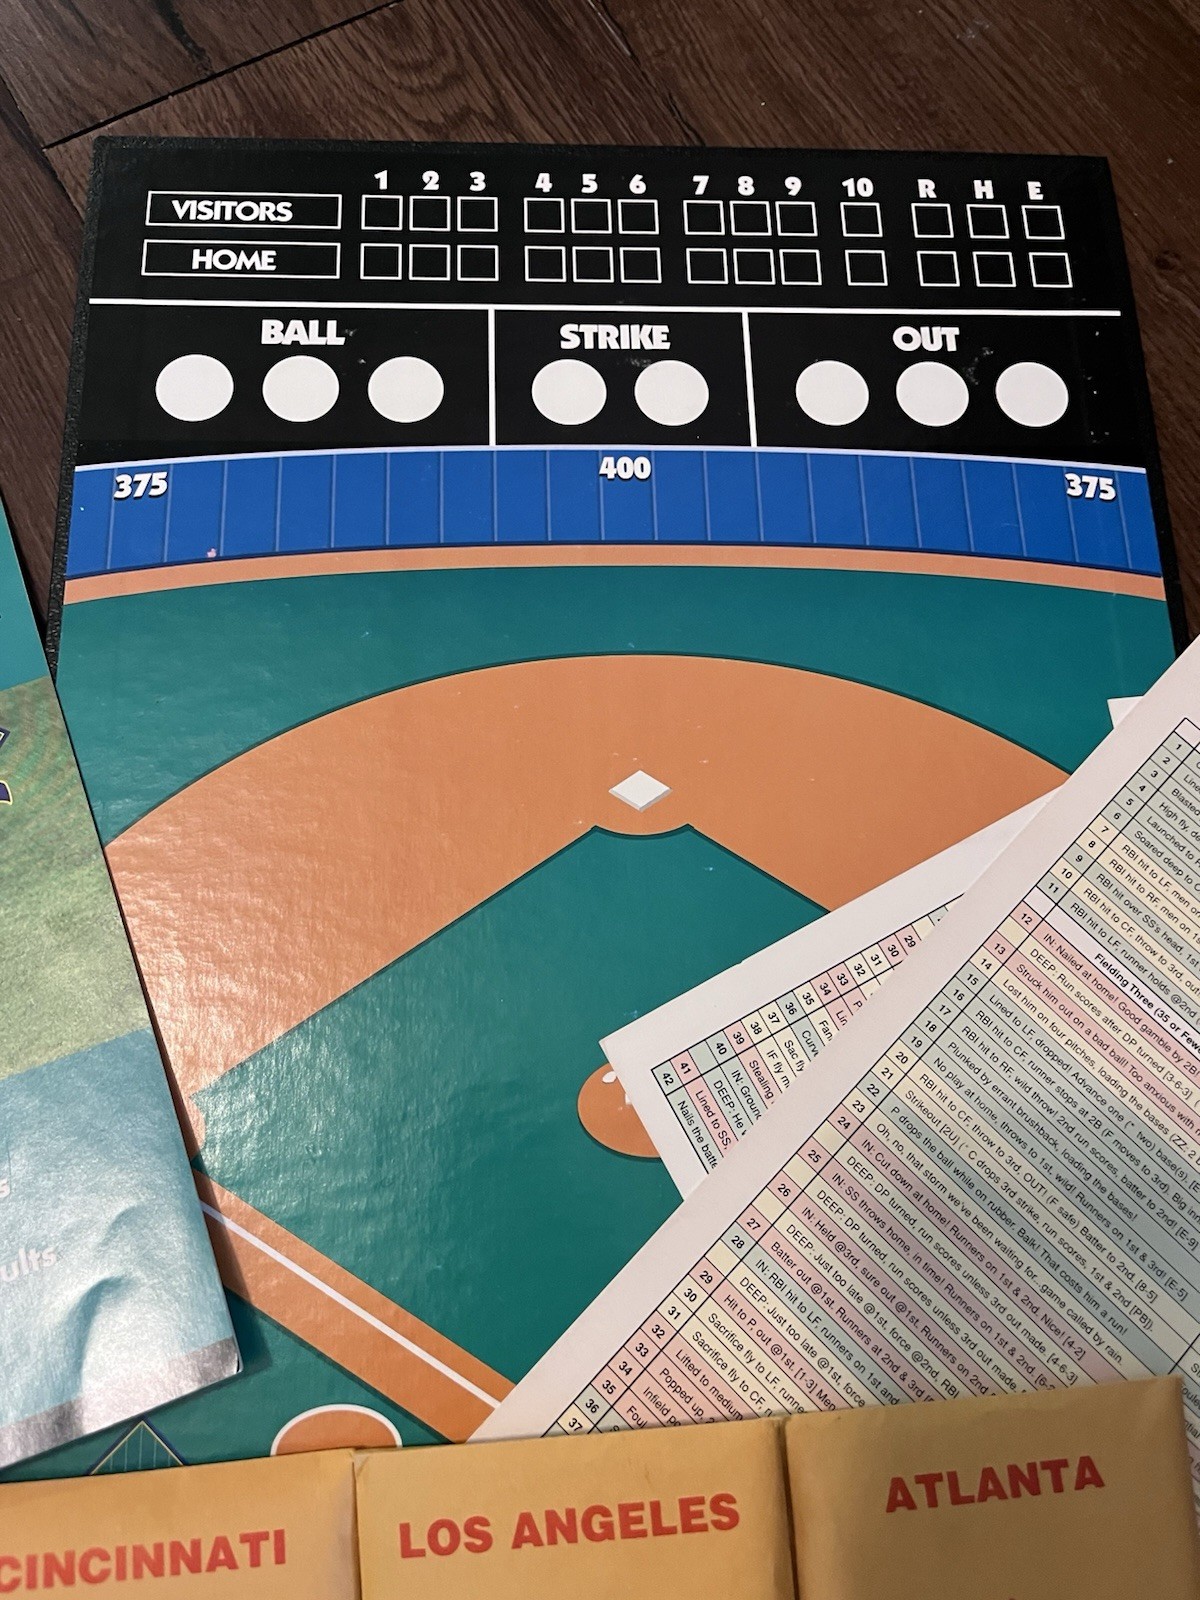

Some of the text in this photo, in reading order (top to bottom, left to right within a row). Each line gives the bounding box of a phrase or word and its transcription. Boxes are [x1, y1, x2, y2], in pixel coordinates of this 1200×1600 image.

[374, 170, 1043, 200] 1 2 3 4 5 6 7 8 9 10 R H E
[172, 200, 292, 222] VISITORS
[192, 249, 276, 270] HOME
[261, 320, 345, 346] BALL
[560, 324, 670, 350] STRIKE
[893, 326, 959, 351] OUT
[599, 457, 651, 480] 400
[113, 472, 168, 499] 375
[1065, 474, 1116, 500] 375
[1162, 756, 1171, 765] 2
[1150, 769, 1159, 778] 3
[1158, 801, 1178, 821] High
[1178, 818, 1189, 832] fly,
[1125, 797, 1194, 860] 5 Launched to
[1087, 840, 1096, 848] 8
[1113, 812, 1193, 885] 6 Soared deep to
[1074, 854, 1083, 863] 9
[1100, 825, 1190, 908] 7 RBI hit to LF, men
[1061, 867, 1073, 879] 10
[1048, 882, 1059, 893] 11
[903, 934, 916, 948] 29
[994, 942, 1006, 955] 13
[887, 943, 900, 957] 30
[870, 953, 882, 966] 31
[980, 958, 992, 970] 14
[853, 962, 866, 977] 32
[836, 972, 849, 986] 33
[966, 973, 979, 986] 15
[819, 982, 832, 996] 34
[952, 988, 965, 1001] 16
[1020, 912, 1033, 925] 12
[1042, 933, 1055, 948] IN:
[1055, 944, 1084, 971] Nailed
[1081, 969, 1092, 980] at
[1090, 977, 1119, 1002] home!
[1117, 1001, 1143, 1025] Good
[1139, 1023, 1172, 1053] gamble
[1171, 1049, 1184, 1063] by
[1094, 952, 1181, 1032] Fielding Three (35 or
[801, 991, 815, 1006] 35
[784, 1001, 798, 1015] 36
[938, 1004, 952, 1015] 17
[749, 1021, 784, 1074] 38 IF fly
[767, 1011, 805, 1072] 37 Sac fly
[910, 1035, 923, 1048] 19
[715, 1042, 727, 1055] 40
[730, 1069, 743, 1086] IN:
[732, 1031, 774, 1100] 39 Stealing
[894, 1051, 909, 1064] 20
[880, 1066, 894, 1080] 21
[866, 1083, 880, 1097] 22
[662, 1072, 674, 1086] 42
[677, 1099, 695, 1126] Nails
[691, 1126, 704, 1143] the
[680, 1062, 732, 1150] 41 Lined to SS,
[712, 1079, 744, 1129] DEEP: He
[851, 1099, 866, 1113] 23
[836, 1116, 851, 1130] 24
[924, 1019, 1138, 1222] 18 Plunked by errant brushback, loading the bases!
[807, 1149, 822, 1163] 25
[746, 1217, 761, 1230] 27
[776, 1183, 896, 1303] 26 IN: Held @3rd, sure out
[698, 1269, 713, 1284] 29
[667, 1305, 681, 1320] 31
[730, 1234, 882, 1389] 28 IN: RBI hit to LF, runners on 1st
[683, 1287, 781, 1389] 30 Sacrifice fly to LF,
[634, 1342, 649, 1357] 33
[651, 1323, 744, 1421] 32 Lifted to medium
[601, 1379, 616, 1395] 35
[618, 1360, 671, 1417] 34 Infield
[585, 1398, 600, 1414] 36
[568, 1417, 583, 1434] 37
[887, 1456, 1105, 1512] ATLANTA
[400, 1494, 740, 1559] LOS ANGELES
[0, 1529, 287, 1593] CINCINNATI
